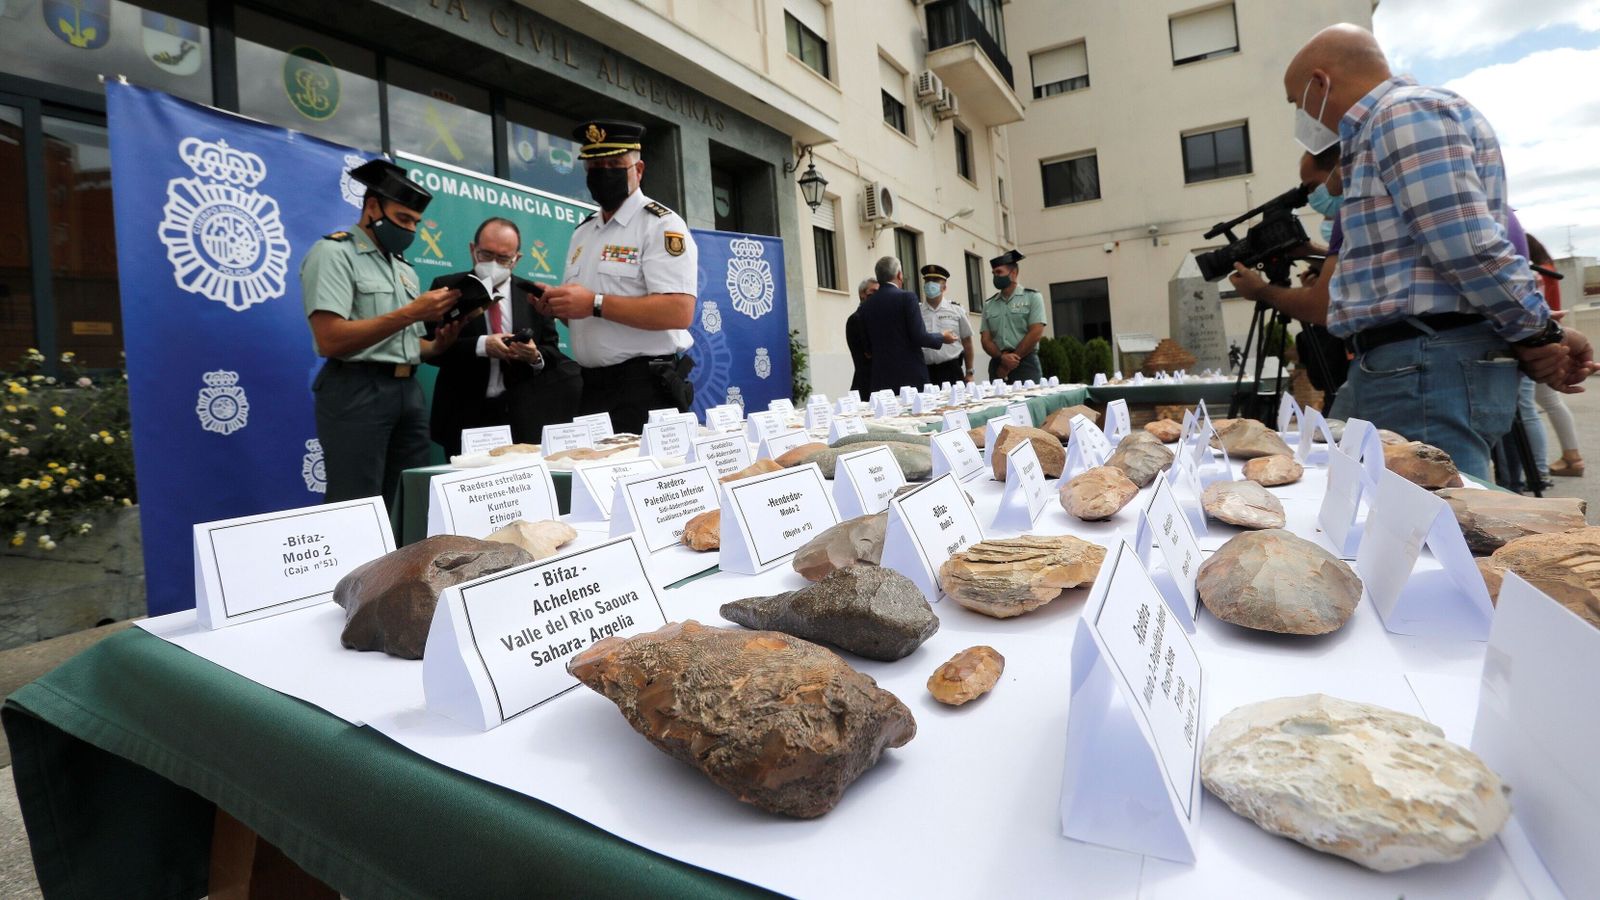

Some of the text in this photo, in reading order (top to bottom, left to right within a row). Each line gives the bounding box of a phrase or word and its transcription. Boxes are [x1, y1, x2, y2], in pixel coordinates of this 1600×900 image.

[490, 9, 579, 69] CIVIL
[597, 57, 724, 132] ALGECIRAS
[410, 169, 552, 218] COMANDANCIA
[554, 206, 575, 224] DE
[458, 472, 534, 493] -Raedera estrellada-
[656, 478, 686, 490] -Raedera-
[680, 485, 704, 498] Inferior
[469, 484, 532, 504] Ateriense-Melka
[768, 492, 803, 508] -Hendedor-
[488, 498, 519, 512] Kunture
[780, 506, 796, 516] Modo
[490, 509, 522, 524] Ethiopia
[283, 533, 325, 548] -Bifaz-
[782, 528, 801, 540] (Objeto
[283, 544, 331, 564] Modo 2
[284, 564, 309, 578] (Caja
[542, 566, 580, 587] Bifaz
[532, 580, 600, 616] Achelense
[500, 590, 639, 652] Valle del Rio Saoura
[530, 614, 634, 668] Sahara- Argelia
